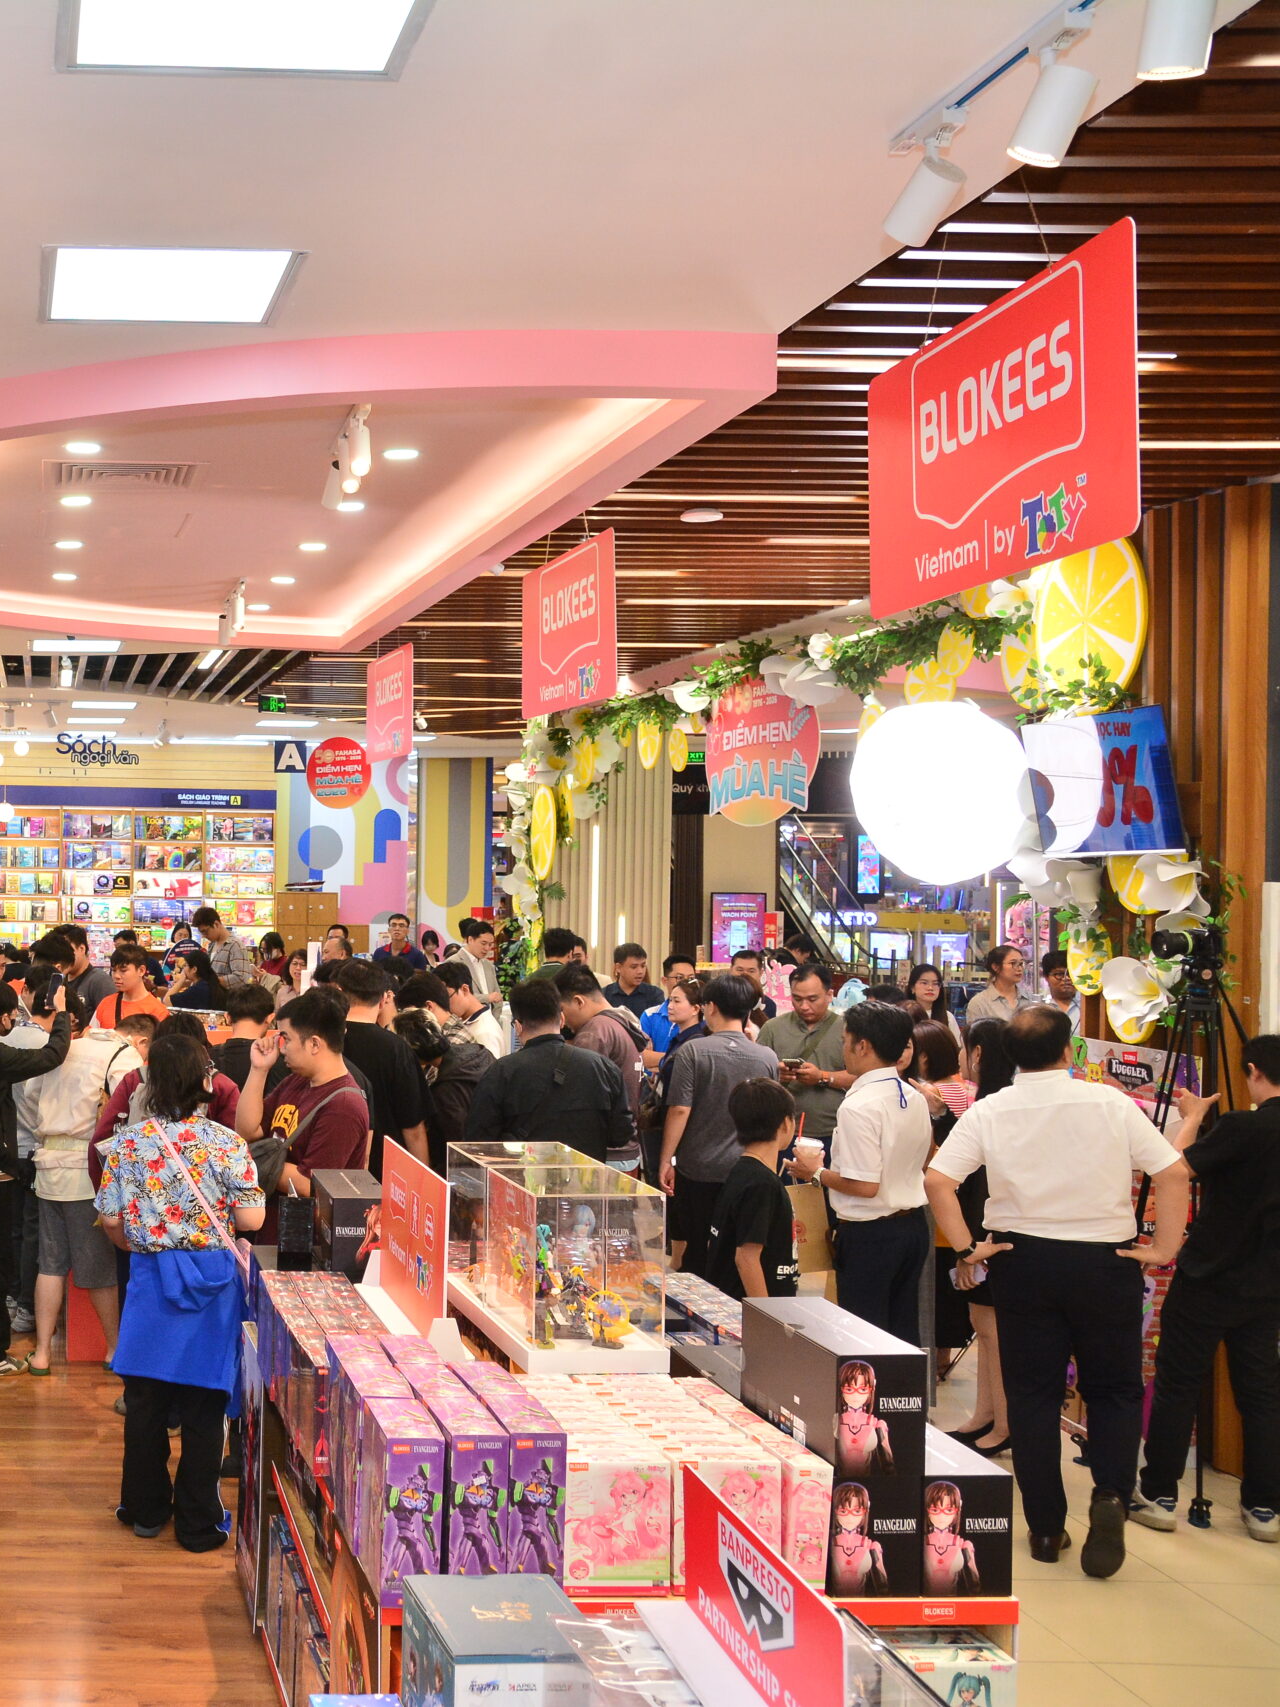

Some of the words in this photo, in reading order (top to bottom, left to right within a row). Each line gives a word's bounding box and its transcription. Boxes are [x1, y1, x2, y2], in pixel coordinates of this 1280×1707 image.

[920, 319, 1073, 465] BLOKEES
[915, 537, 979, 582] Vietnam
[993, 524, 1016, 556] by
[542, 573, 596, 635] BLOKEES
[375, 671, 403, 707] BLOKEES
[540, 683, 564, 702] Vietnam
[568, 677, 577, 697] by
[723, 720, 757, 751] ĐIỂM
[759, 720, 792, 748] HẸN
[1113, 722, 1132, 737] HAY
[71, 750, 111, 766] ngoại
[112, 751, 139, 765] văn
[276, 743, 305, 770] A
[340, 764, 361, 775] HẸN
[710, 753, 765, 816] MÙA
[768, 748, 808, 812] HÈ
[232, 796, 239, 805] A
[335, 1226, 366, 1236] EVANGELION
[598, 1228, 630, 1237] EVANGELION
[388, 1232, 406, 1265] Vietnam
[409, 1259, 415, 1278] by
[879, 1397, 922, 1409] EVANGELION
[873, 1518, 916, 1531] EVANGELION
[965, 1517, 1008, 1531] EVANGELION
[721, 1521, 791, 1614] BANPRESTO
[924, 1607, 953, 1616] BLOKEES
[698, 1586, 780, 1702] PARTNERSHIP
